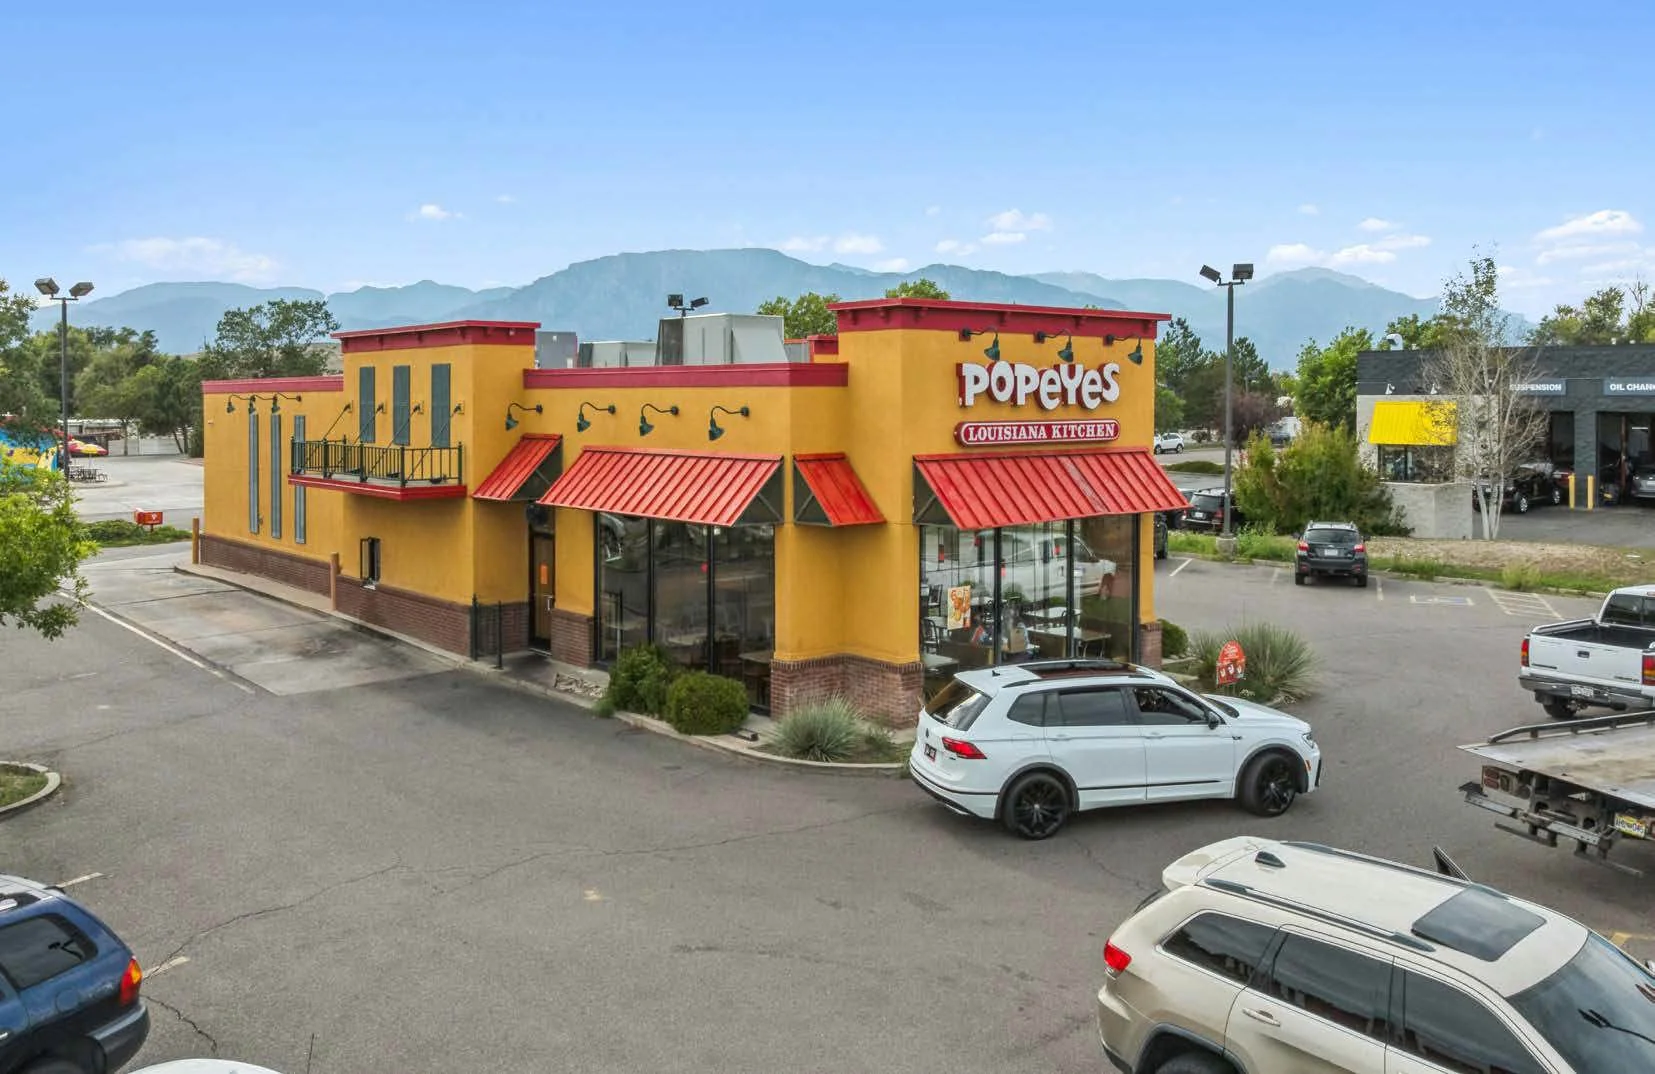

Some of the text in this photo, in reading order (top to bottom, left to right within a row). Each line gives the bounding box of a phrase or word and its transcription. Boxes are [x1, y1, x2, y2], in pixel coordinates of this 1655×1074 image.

[1610, 383, 1625, 391] OIL
[968, 423, 1114, 441] LOUISIANA KITCHEN
